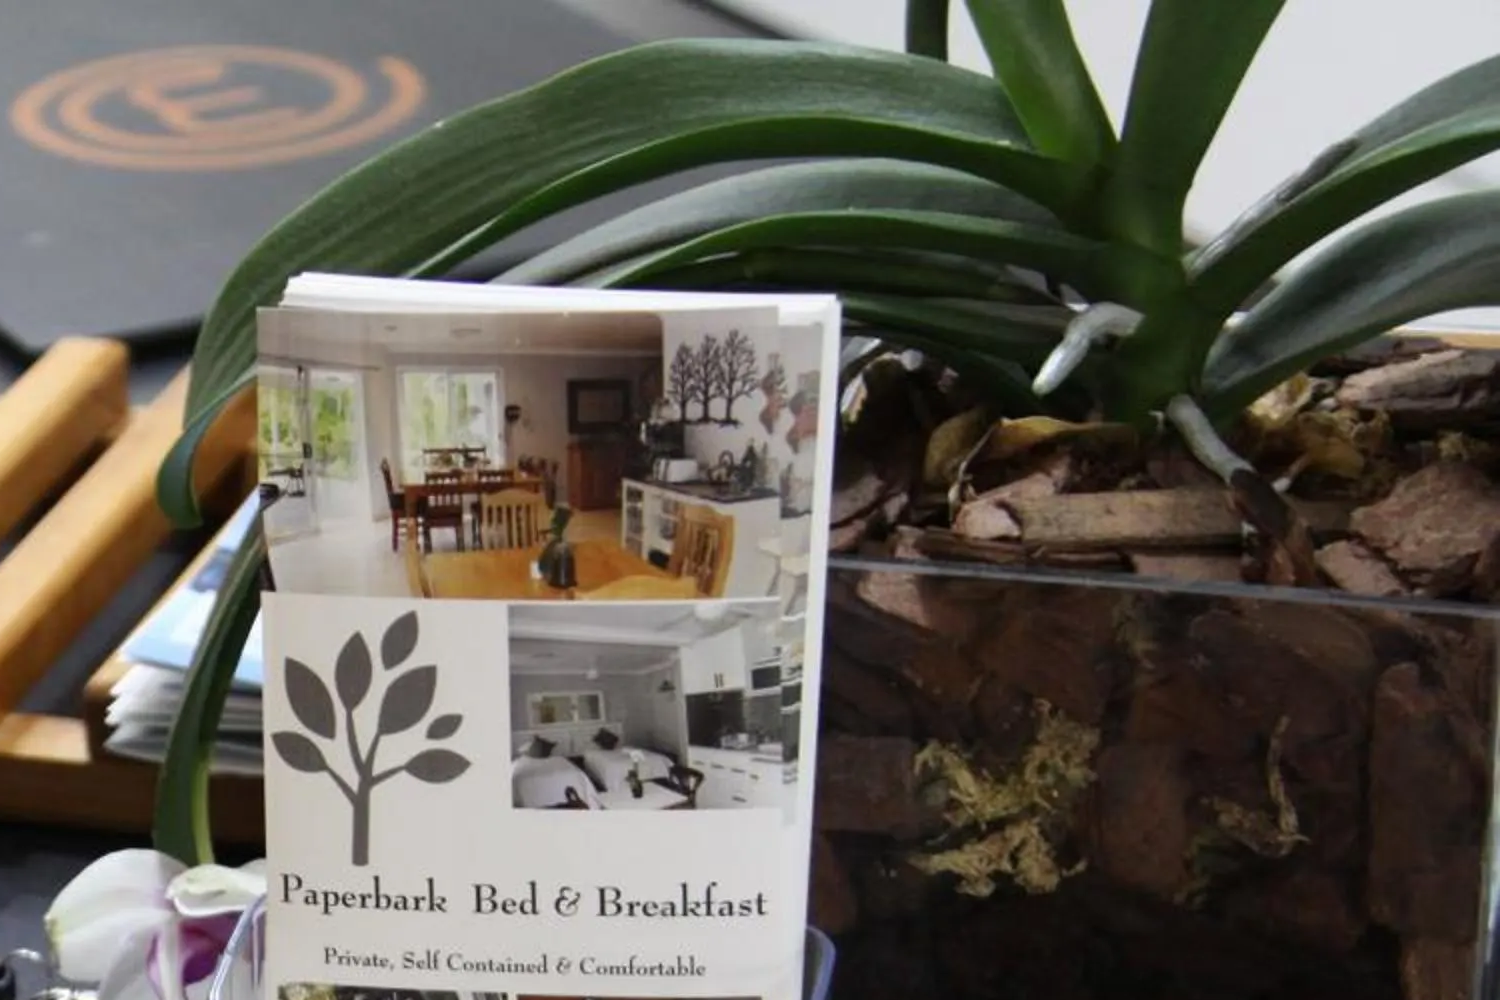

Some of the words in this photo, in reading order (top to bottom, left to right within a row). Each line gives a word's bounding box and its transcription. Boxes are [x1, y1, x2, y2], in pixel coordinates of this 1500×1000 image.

[280, 872, 449, 916] Paperbark
[472, 879, 540, 916] Bed
[554, 885, 582, 917] &
[595, 881, 768, 918] Breakfast
[323, 946, 395, 971] Private,
[401, 948, 440, 971] Self
[446, 952, 548, 975] Contained
[555, 956, 572, 975] &
[578, 953, 707, 978] Comfortable
